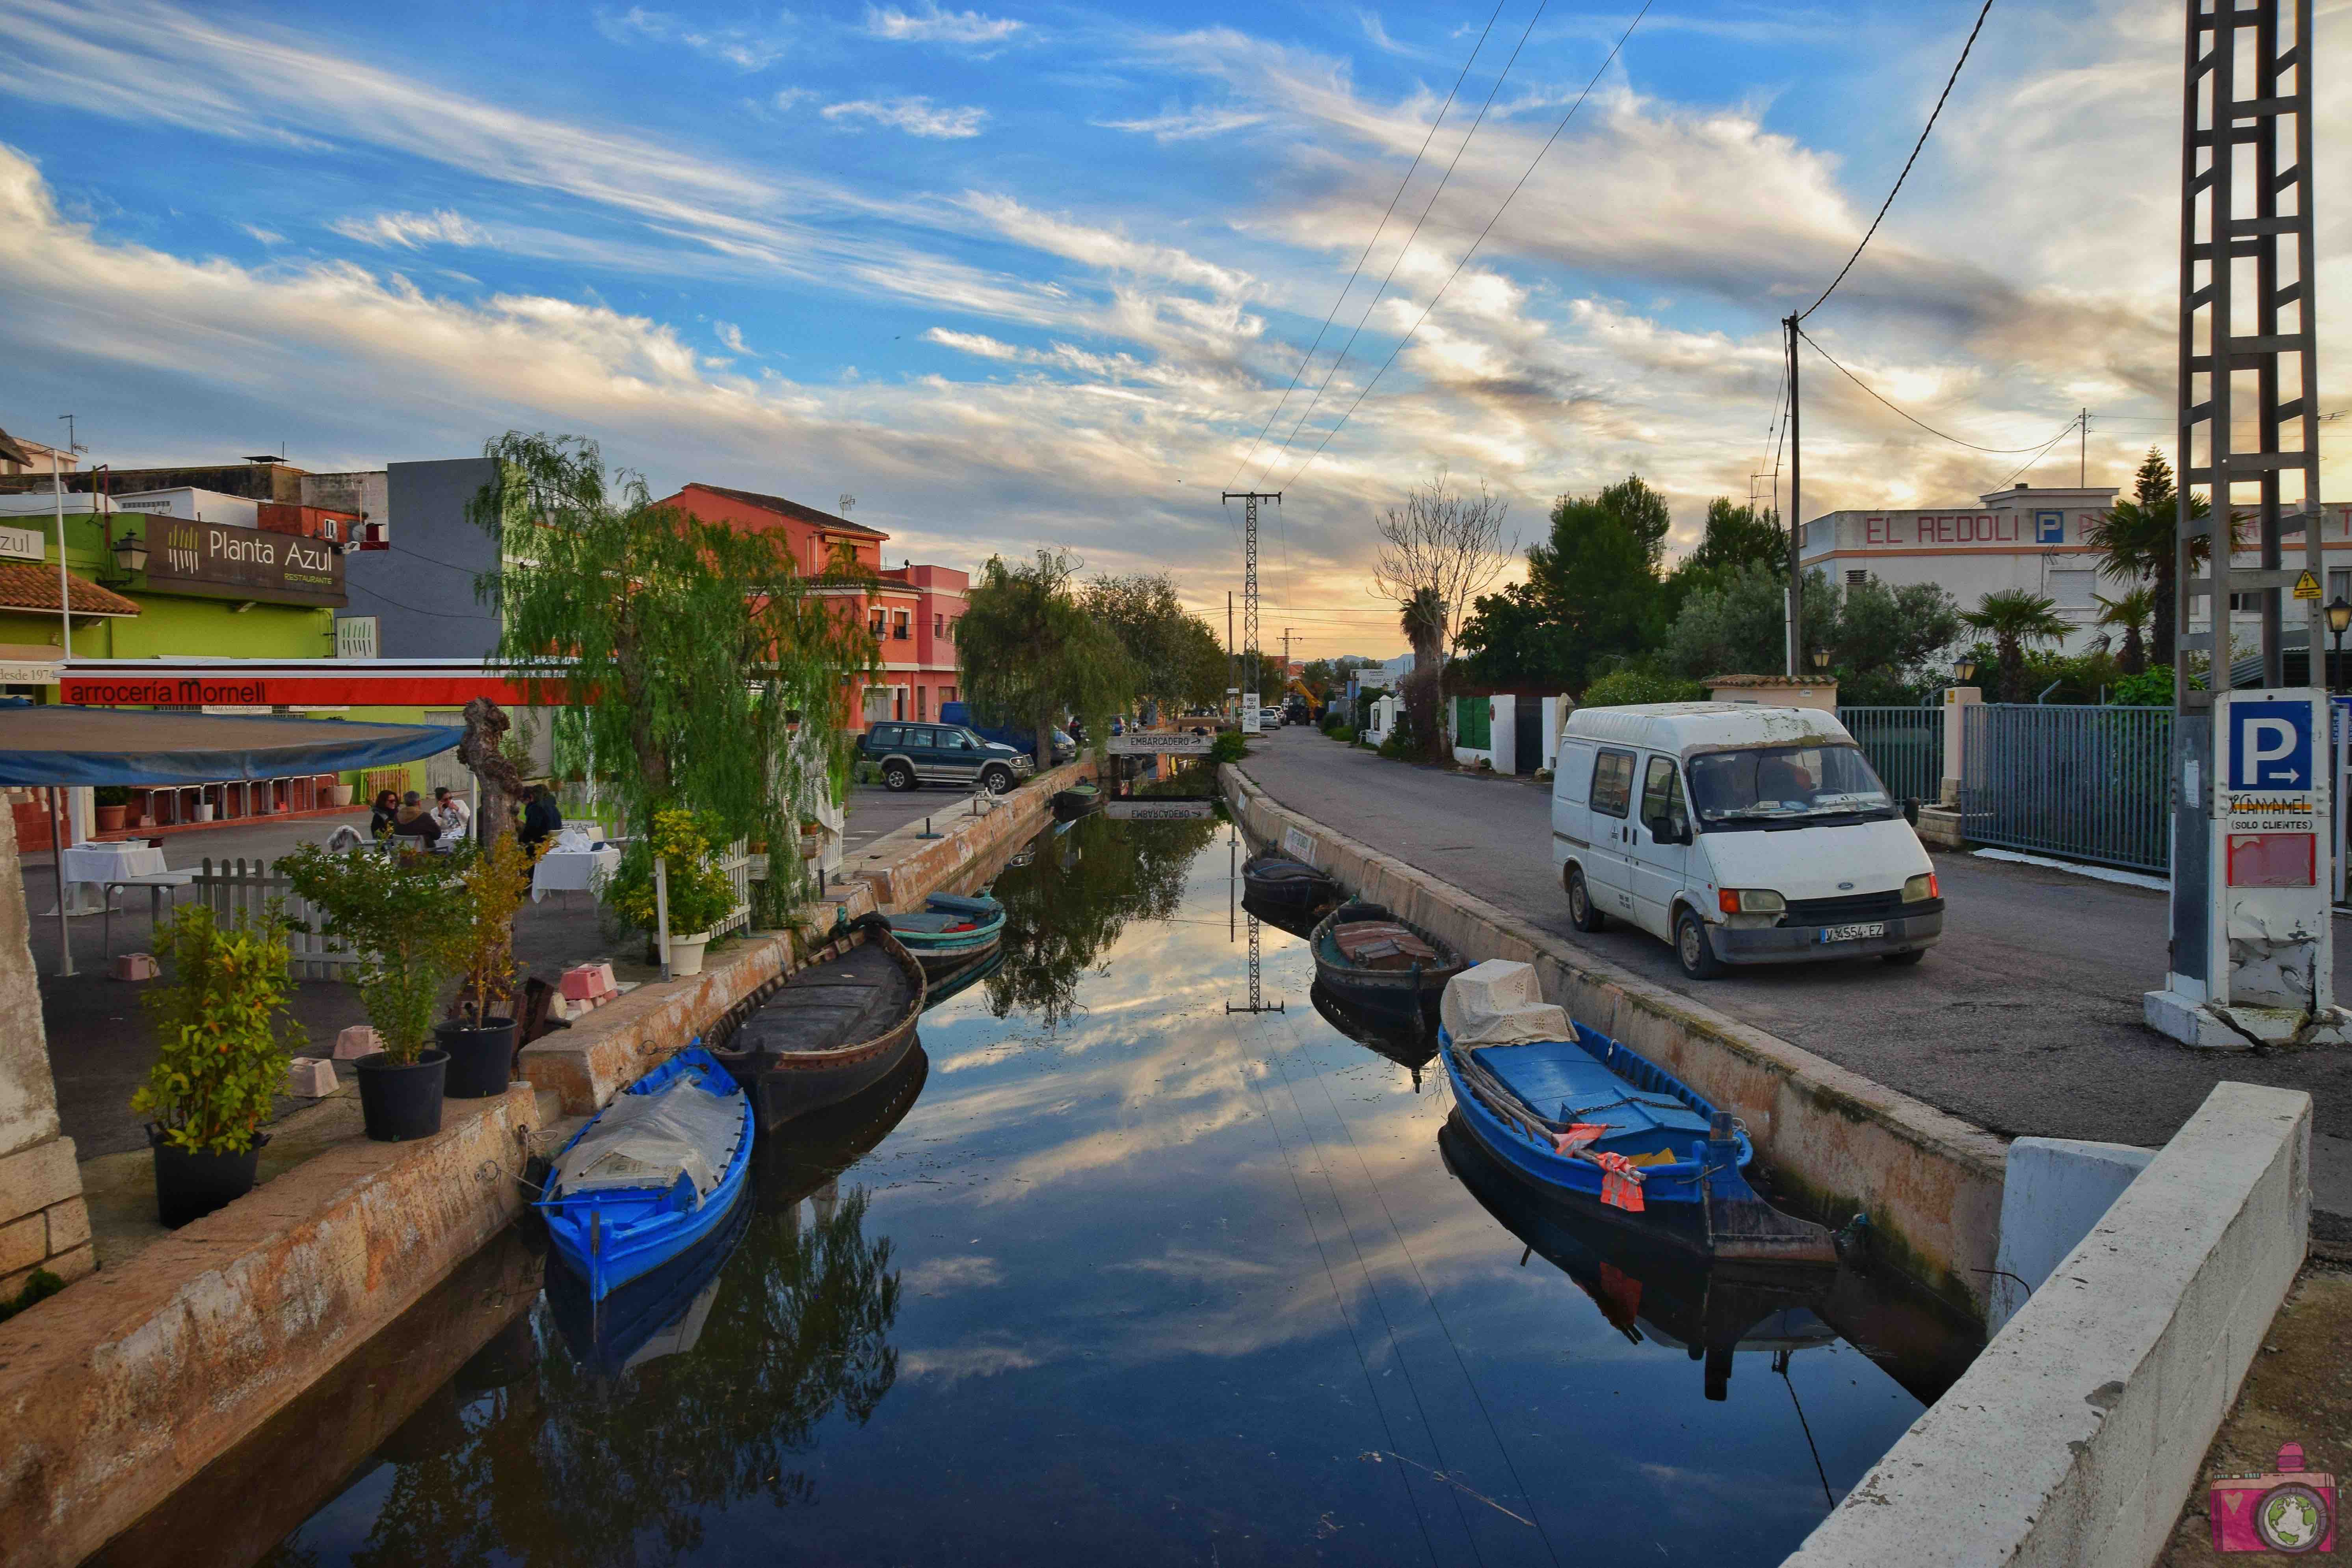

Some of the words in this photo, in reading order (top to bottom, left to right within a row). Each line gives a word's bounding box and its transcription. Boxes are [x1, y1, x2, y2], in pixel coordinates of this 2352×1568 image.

[1866, 517, 1903, 544] EL
[1917, 515, 2019, 543] REDOLI
[210, 530, 274, 564] Planta
[284, 542, 332, 571] Azul
[284, 573, 332, 584] RESTAURANTE
[71, 681, 172, 702] arrocería
[1130, 737, 1189, 746] EMBARCADERO
[2243, 718, 2297, 784] P
